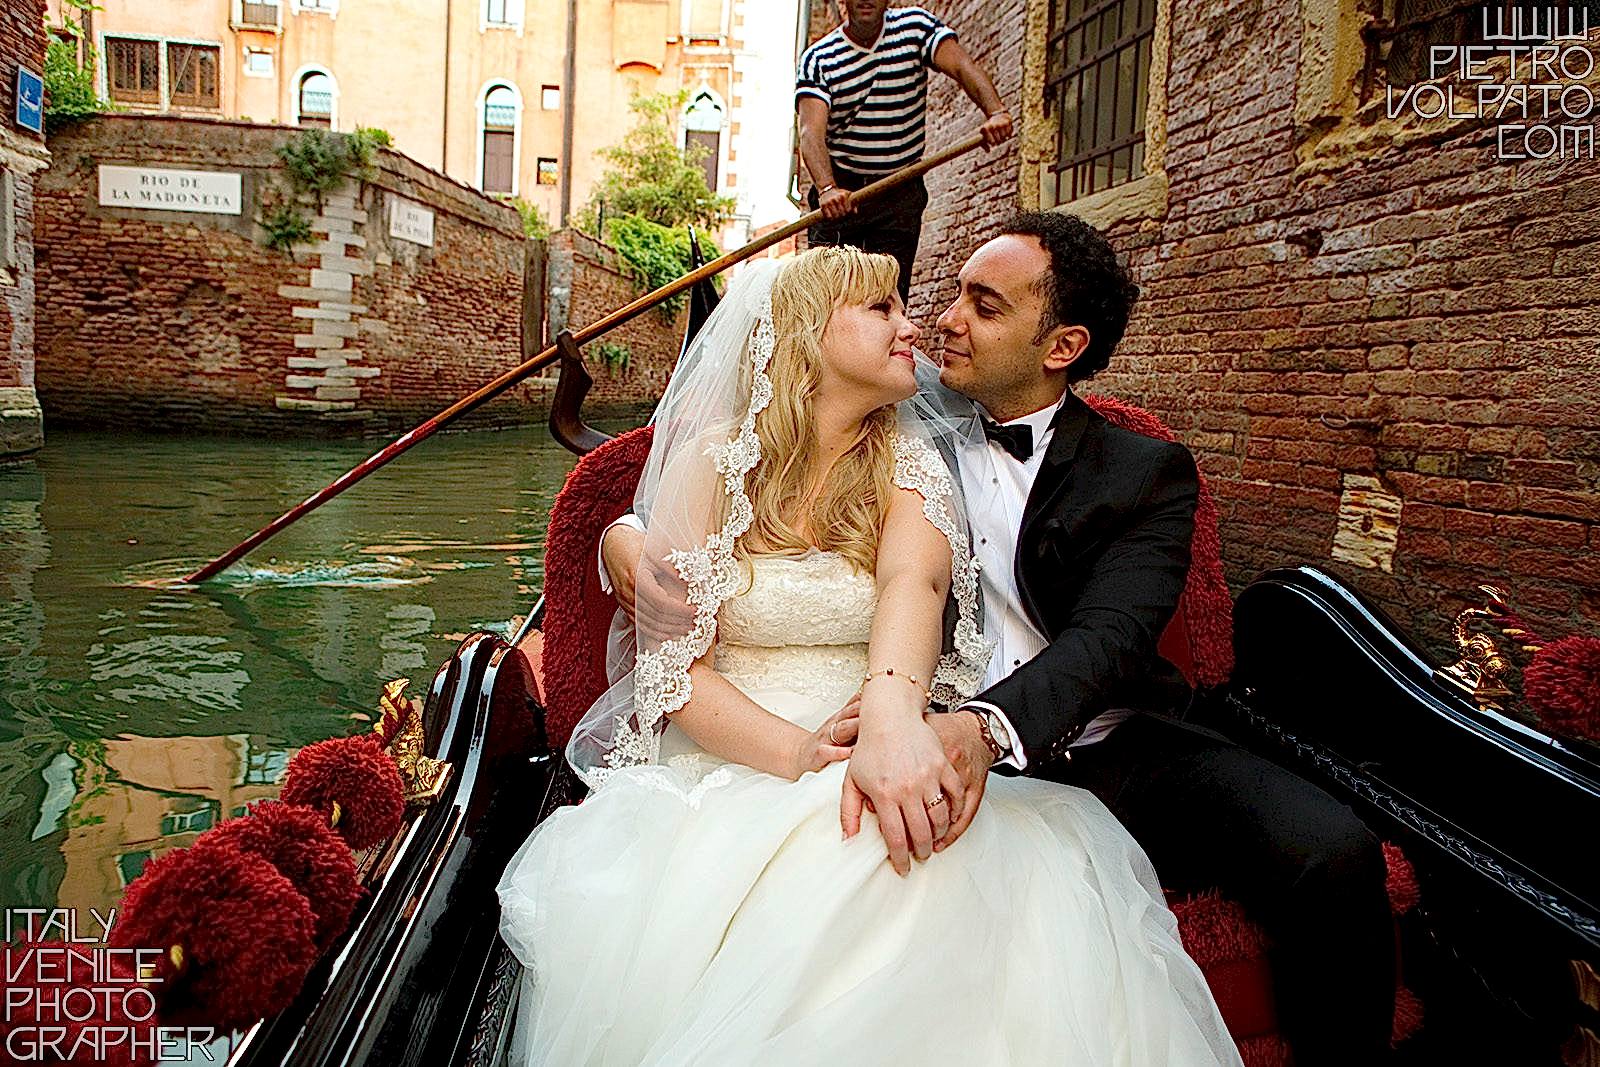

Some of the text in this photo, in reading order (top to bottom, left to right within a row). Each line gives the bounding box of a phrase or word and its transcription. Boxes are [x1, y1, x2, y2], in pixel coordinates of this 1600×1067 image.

[141, 175, 200, 188] RIO DE
[112, 189, 231, 206] LA MADONETA
